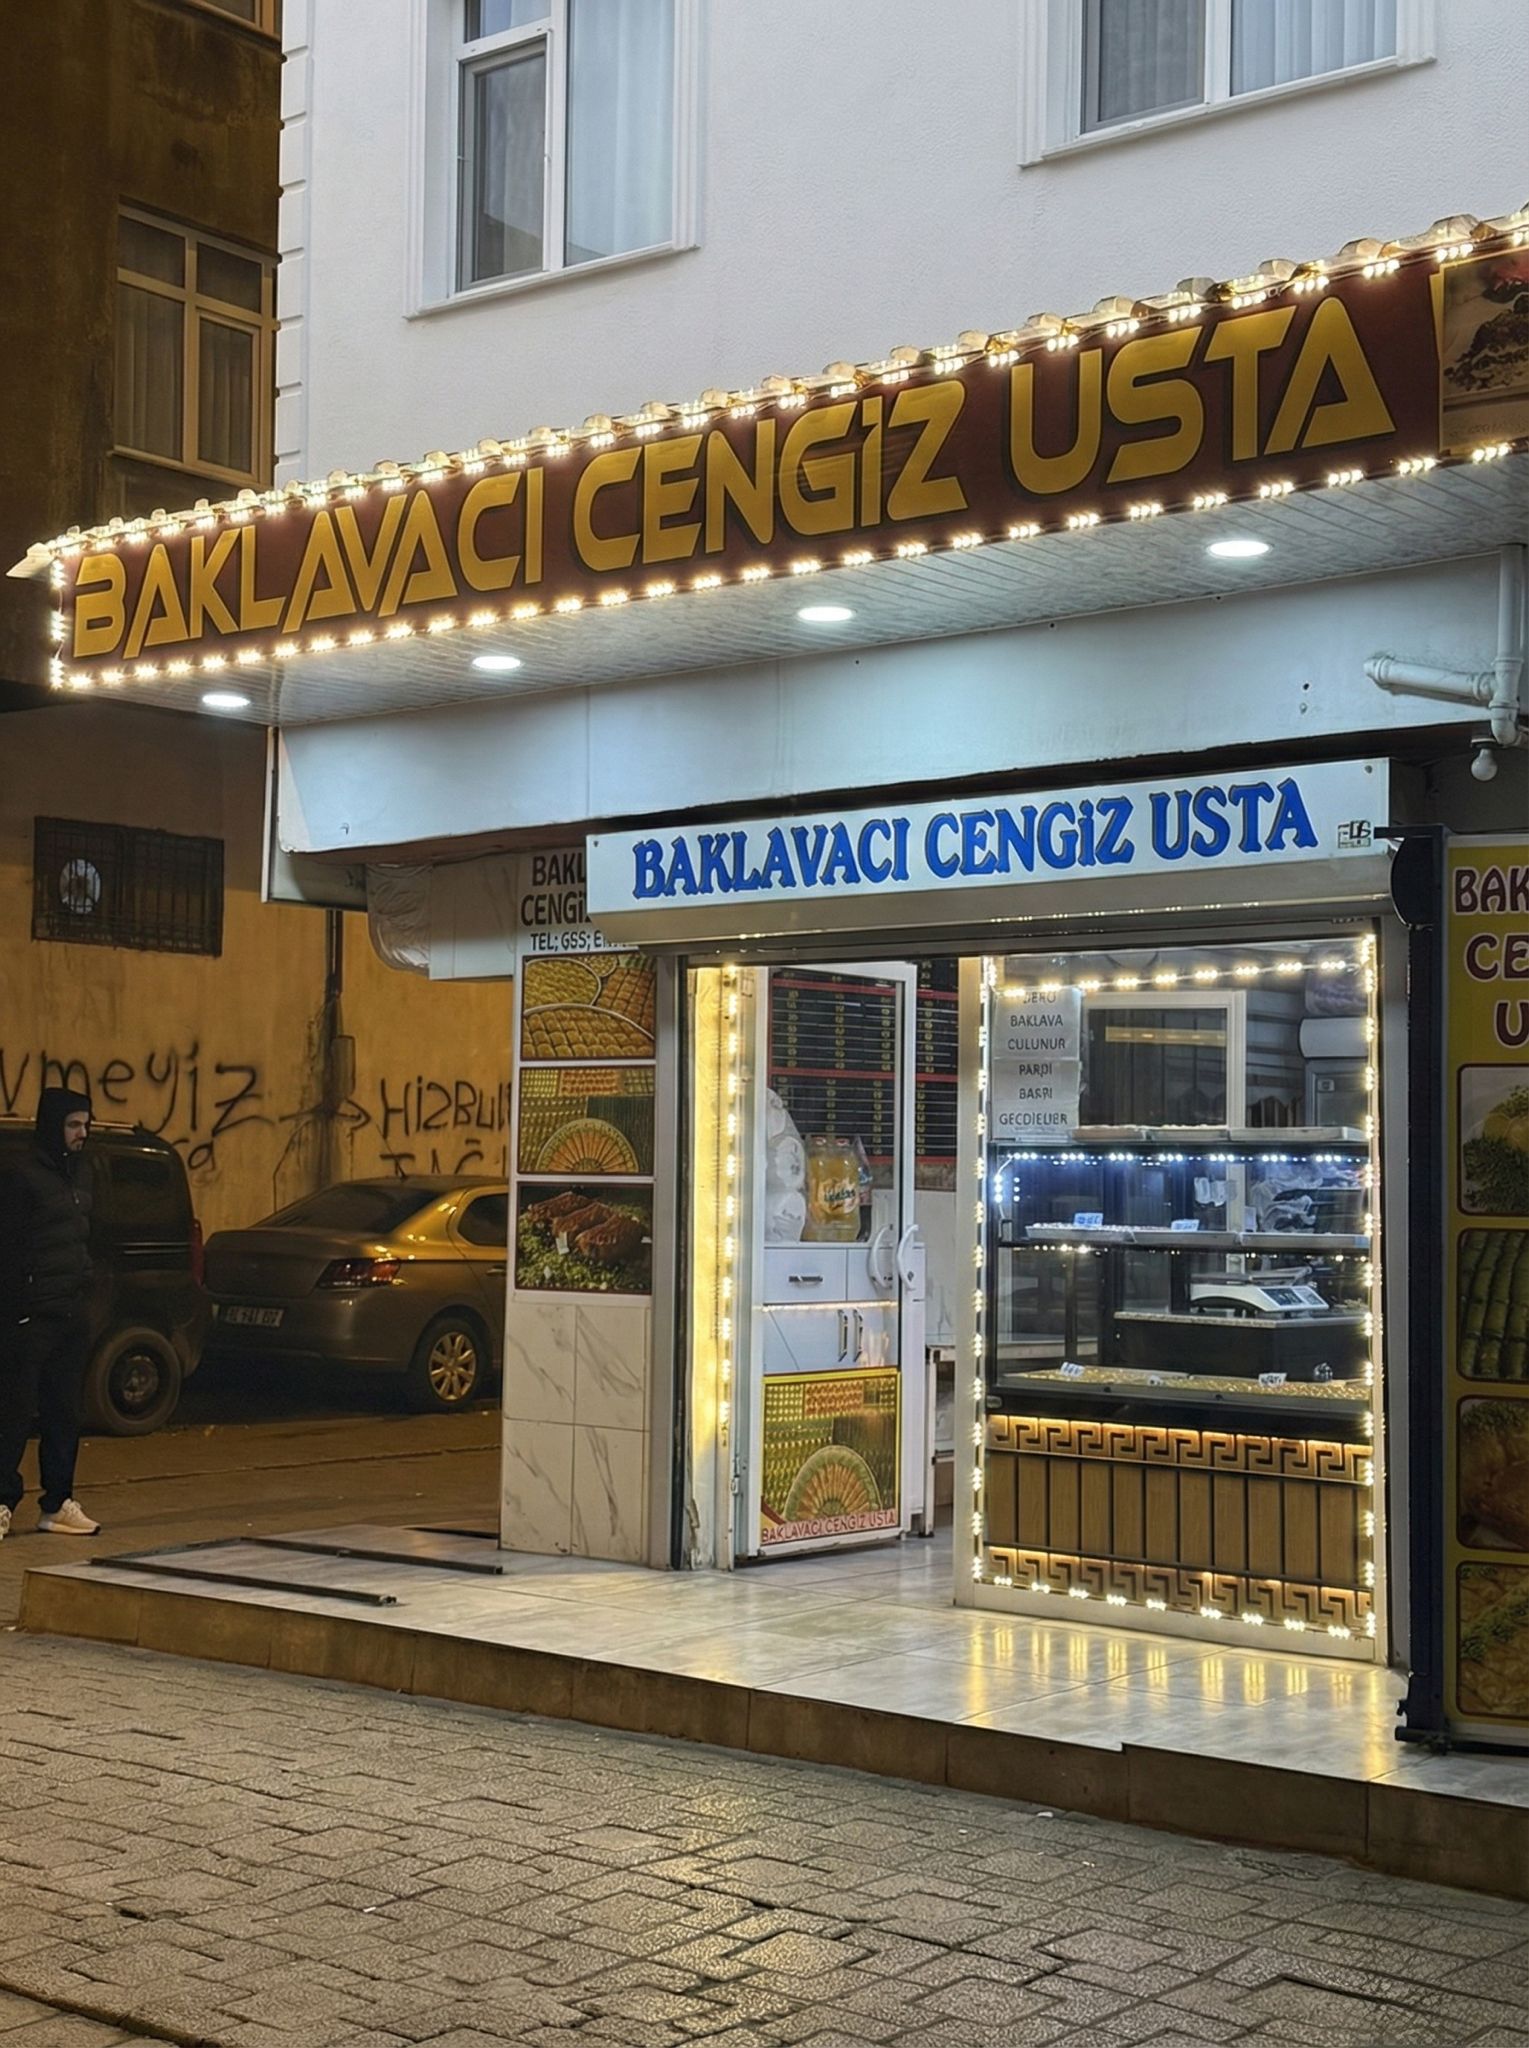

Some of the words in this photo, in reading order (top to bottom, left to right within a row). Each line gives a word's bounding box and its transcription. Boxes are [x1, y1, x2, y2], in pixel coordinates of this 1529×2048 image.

[73, 466, 546, 660] BAKLAVACI
[1010, 296, 1396, 496] USTA
[632, 818, 911, 900] BAKLAVACI
[1149, 776, 1320, 861] USTA
